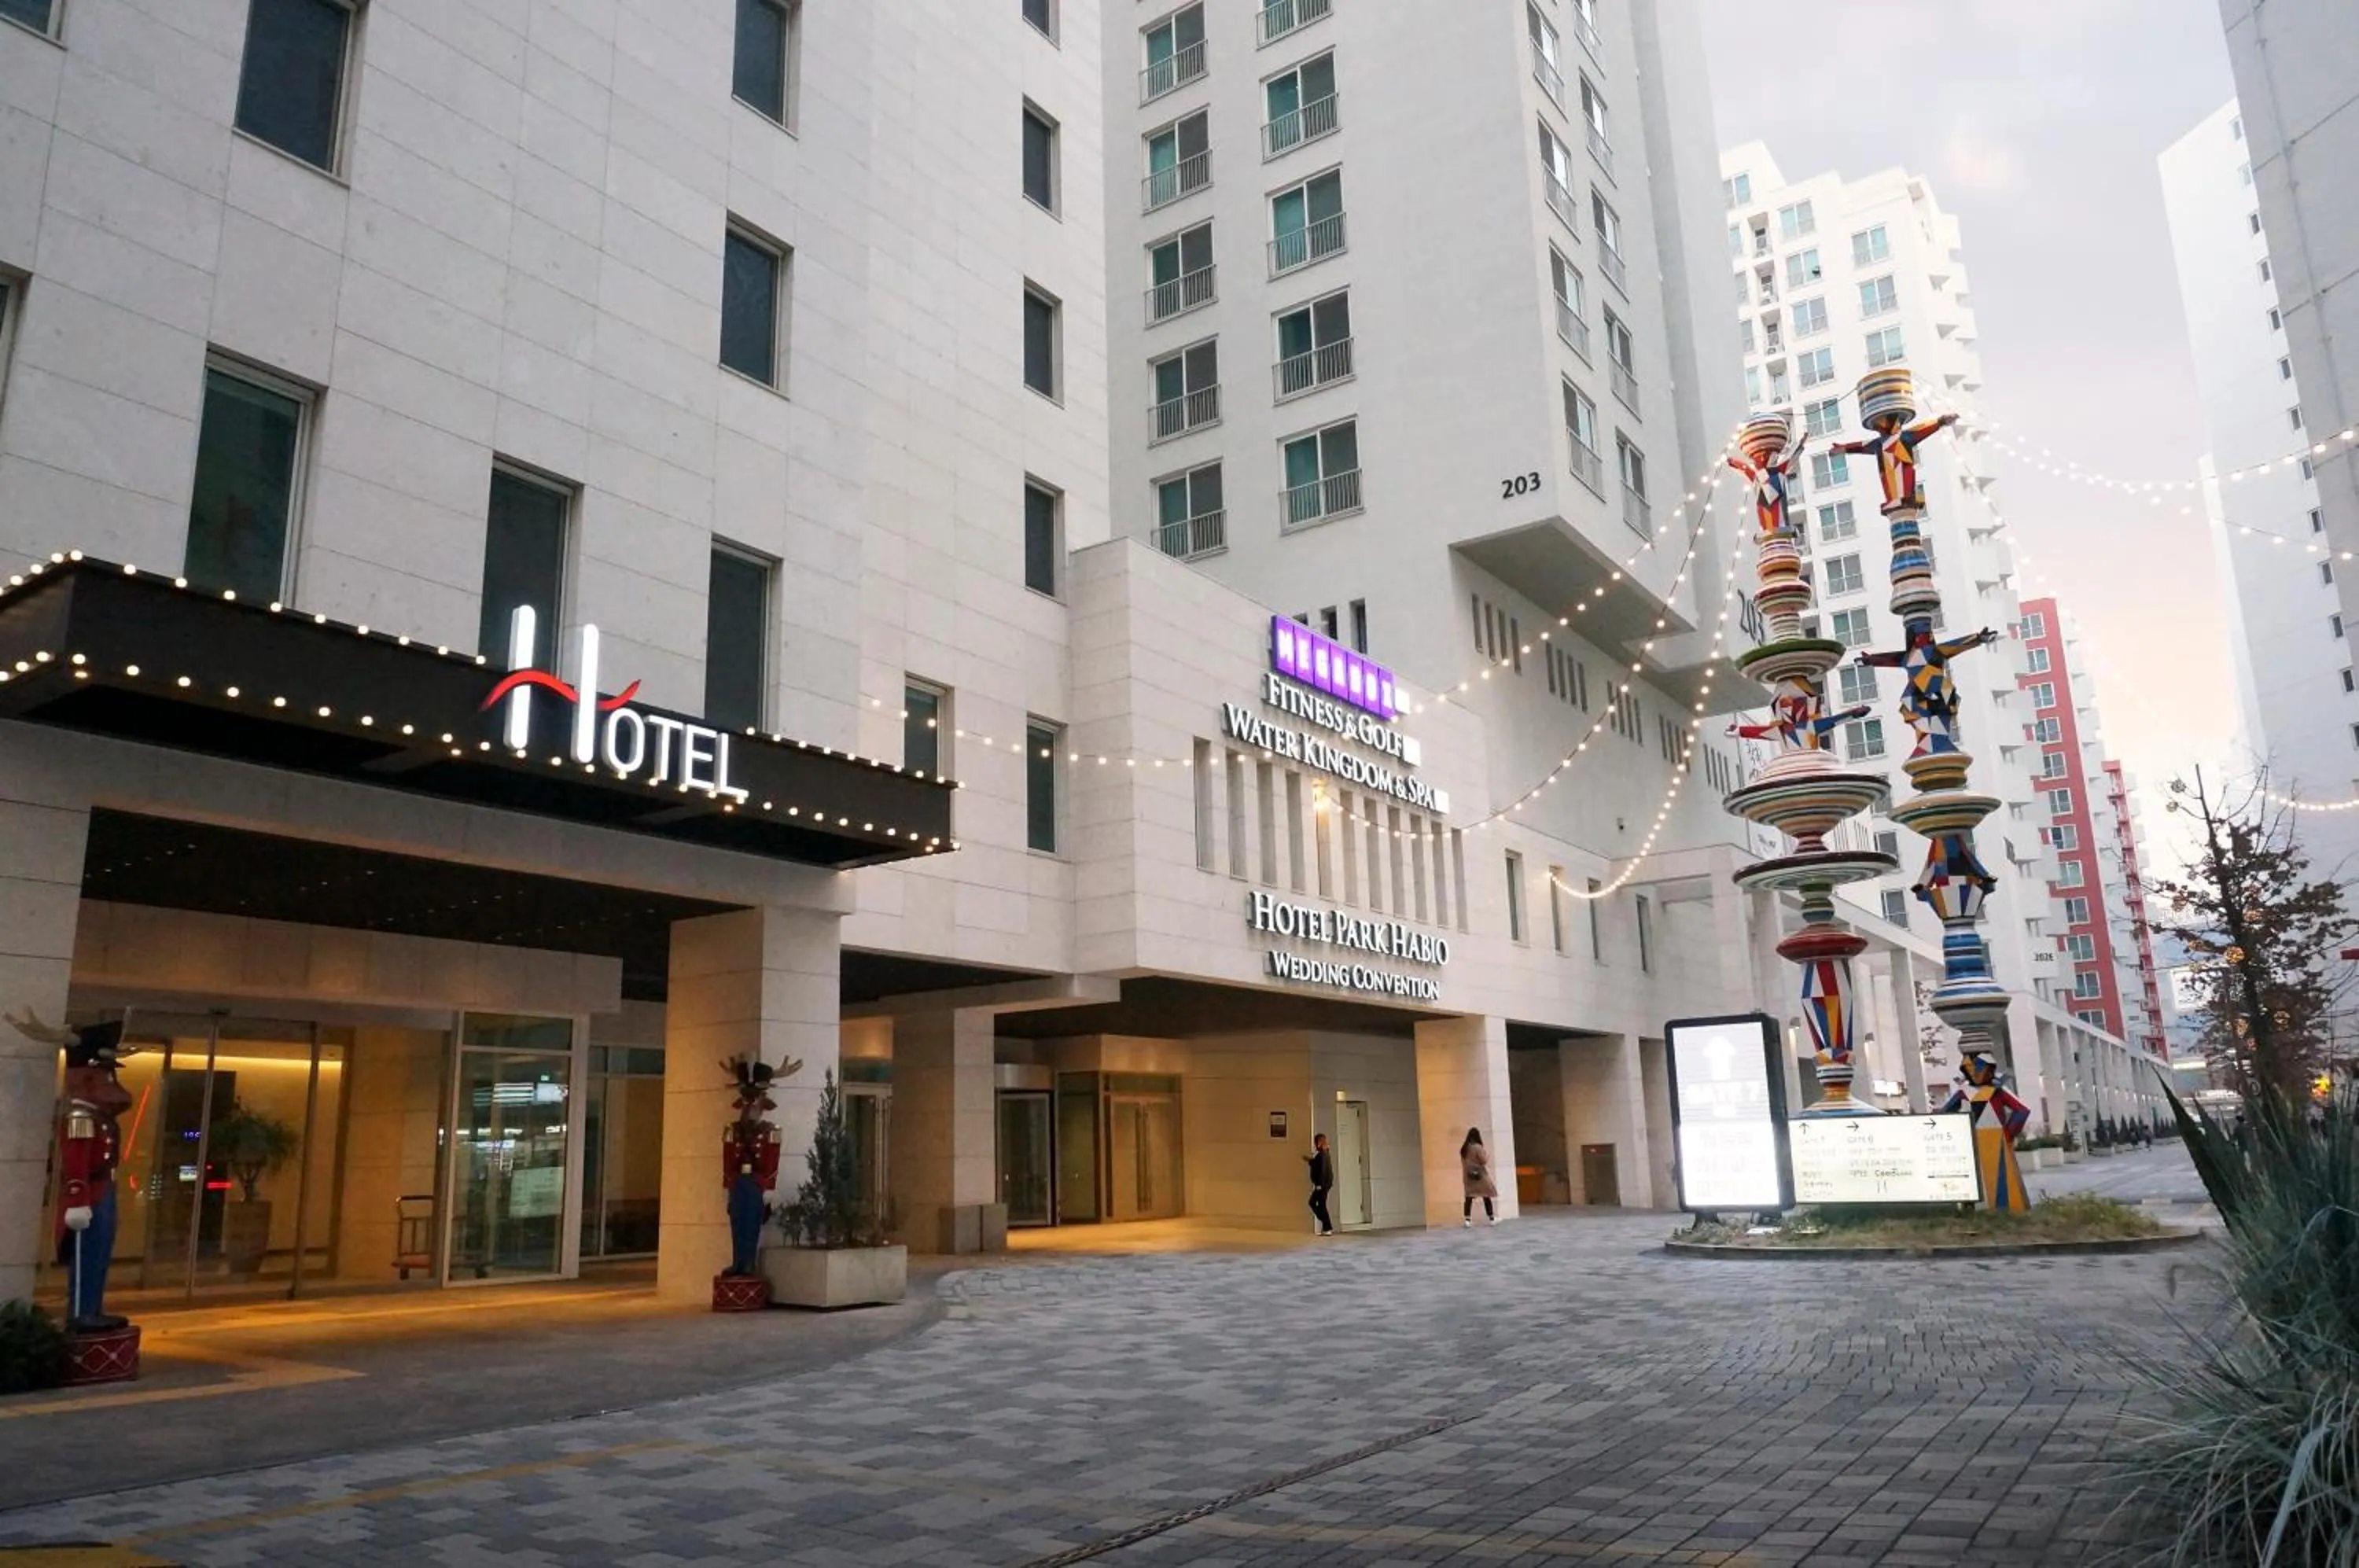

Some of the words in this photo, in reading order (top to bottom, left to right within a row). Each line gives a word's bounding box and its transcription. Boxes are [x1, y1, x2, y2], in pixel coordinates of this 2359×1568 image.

[1500, 471, 1541, 499] 203
[481, 604, 749, 799] HOTEL
[1266, 672, 1344, 733] FITNESS
[1345, 712, 1359, 739] &
[1358, 713, 1403, 757] GOLF
[1225, 701, 1301, 760] WATER
[1302, 732, 1393, 795] KINGDOM
[1396, 774, 1408, 800] &
[1408, 774, 1435, 810] SPA
[1251, 890, 1332, 943] HOTEL
[1334, 909, 1390, 955] PARK
[1389, 922, 1450, 966] HABIO
[1272, 949, 1350, 988] WEDDING
[1352, 963, 1441, 1000] CONVENTION
